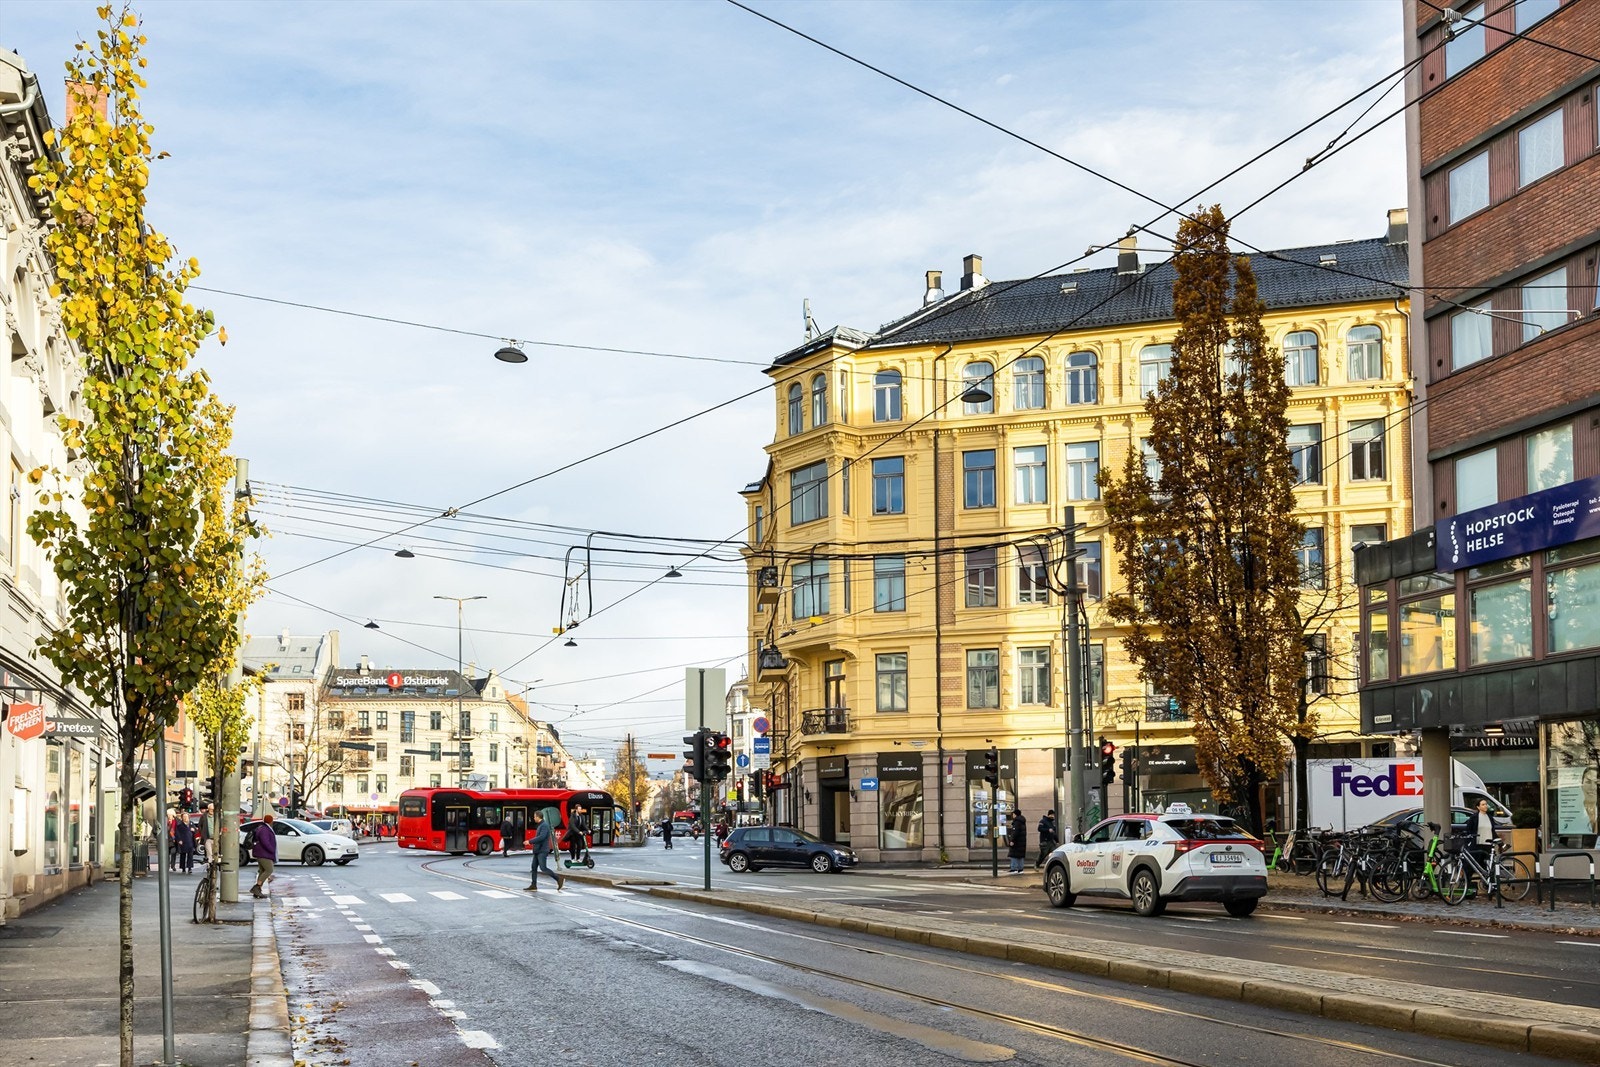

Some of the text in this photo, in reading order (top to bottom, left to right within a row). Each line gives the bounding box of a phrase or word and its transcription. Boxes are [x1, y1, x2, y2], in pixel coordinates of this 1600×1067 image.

[1553, 500, 1579, 512] Fysioterapi
[1553, 509, 1575, 519] Osteopat
[1466, 507, 1535, 536] HOPSTOCK
[1553, 517, 1574, 525] Massasje
[1466, 533, 1504, 552] HELSE
[336, 675, 449, 686] SpareBank 1 Østlandet
[13, 716, 41, 734] ARMEEN
[56, 722, 94, 733] Fretex
[1470, 737, 1534, 747] HAIR CREW
